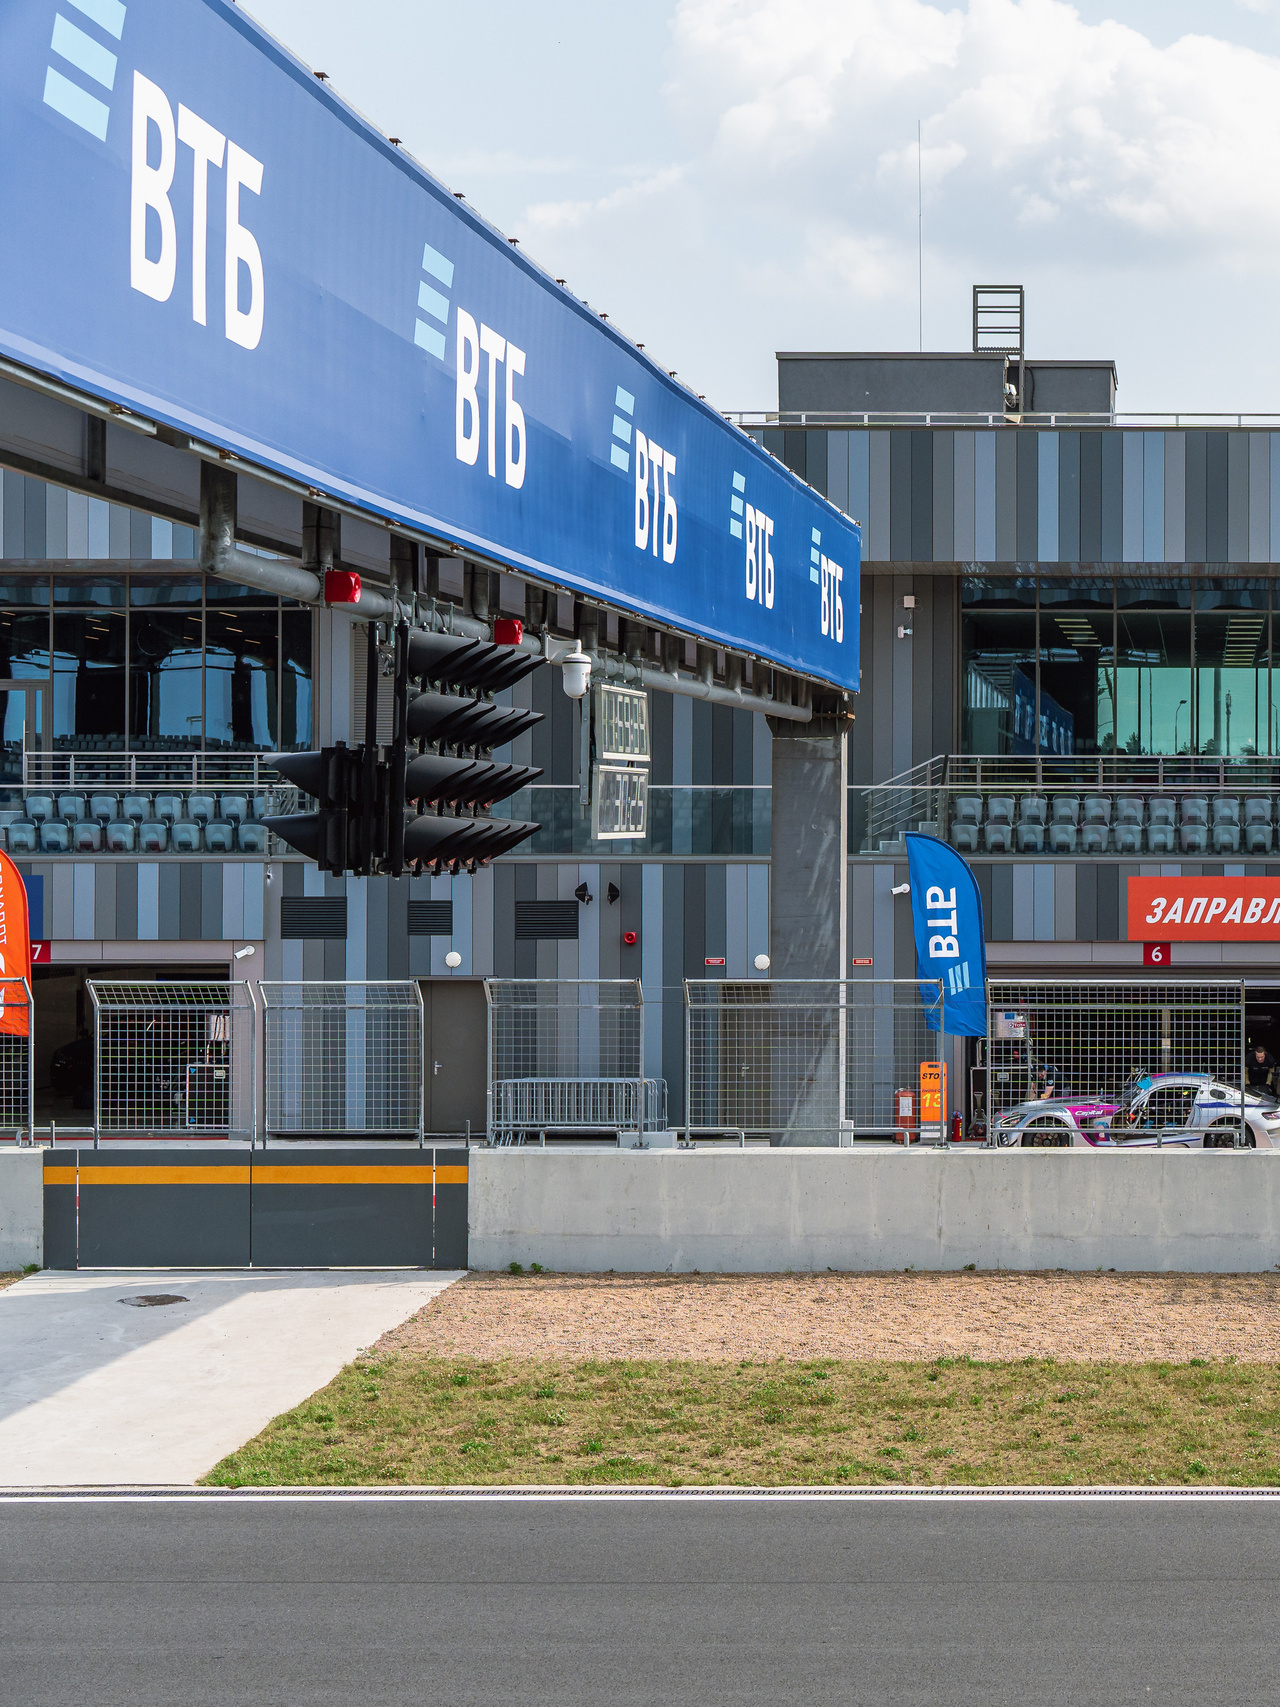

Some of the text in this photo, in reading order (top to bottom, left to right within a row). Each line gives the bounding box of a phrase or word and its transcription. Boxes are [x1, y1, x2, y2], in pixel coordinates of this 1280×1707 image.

[131, 70, 264, 349] ВТБ
[456, 307, 526, 489] ВТБ
[636, 429, 677, 563] ВТБ
[746, 503, 774, 609] ВТБ
[821, 554, 843, 643] ВТБ
[32, 944, 42, 960] 7
[927, 887, 959, 957] ВТБ
[1151, 946, 1163, 962] 6
